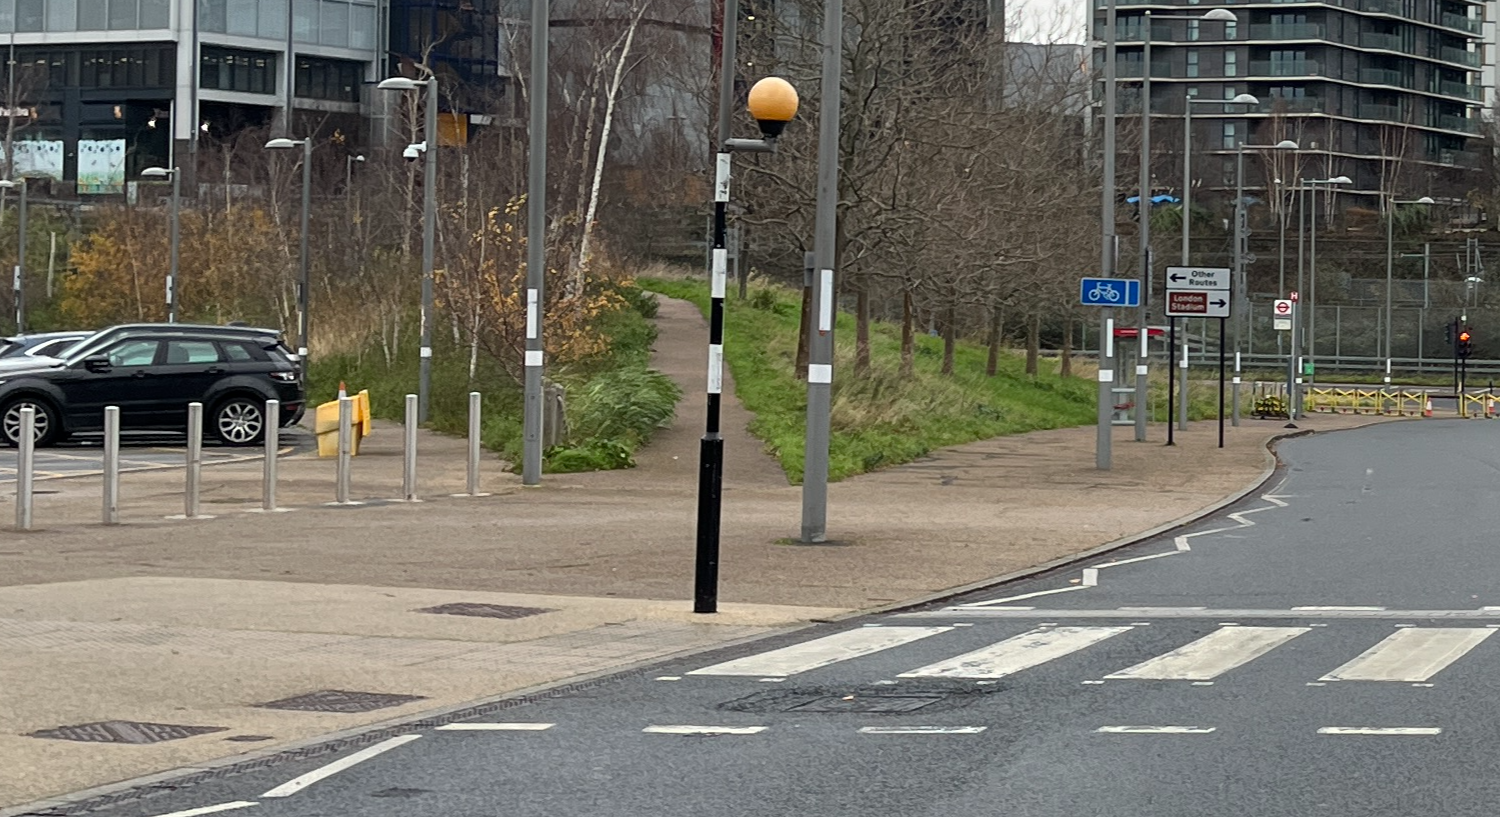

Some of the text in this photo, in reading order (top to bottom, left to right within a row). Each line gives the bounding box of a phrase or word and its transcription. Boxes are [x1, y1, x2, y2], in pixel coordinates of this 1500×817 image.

[1191, 270, 1215, 278] Other
[1173, 294, 1203, 302] London
[1290, 292, 1298, 300] H
[1171, 303, 1205, 311] Stadium
